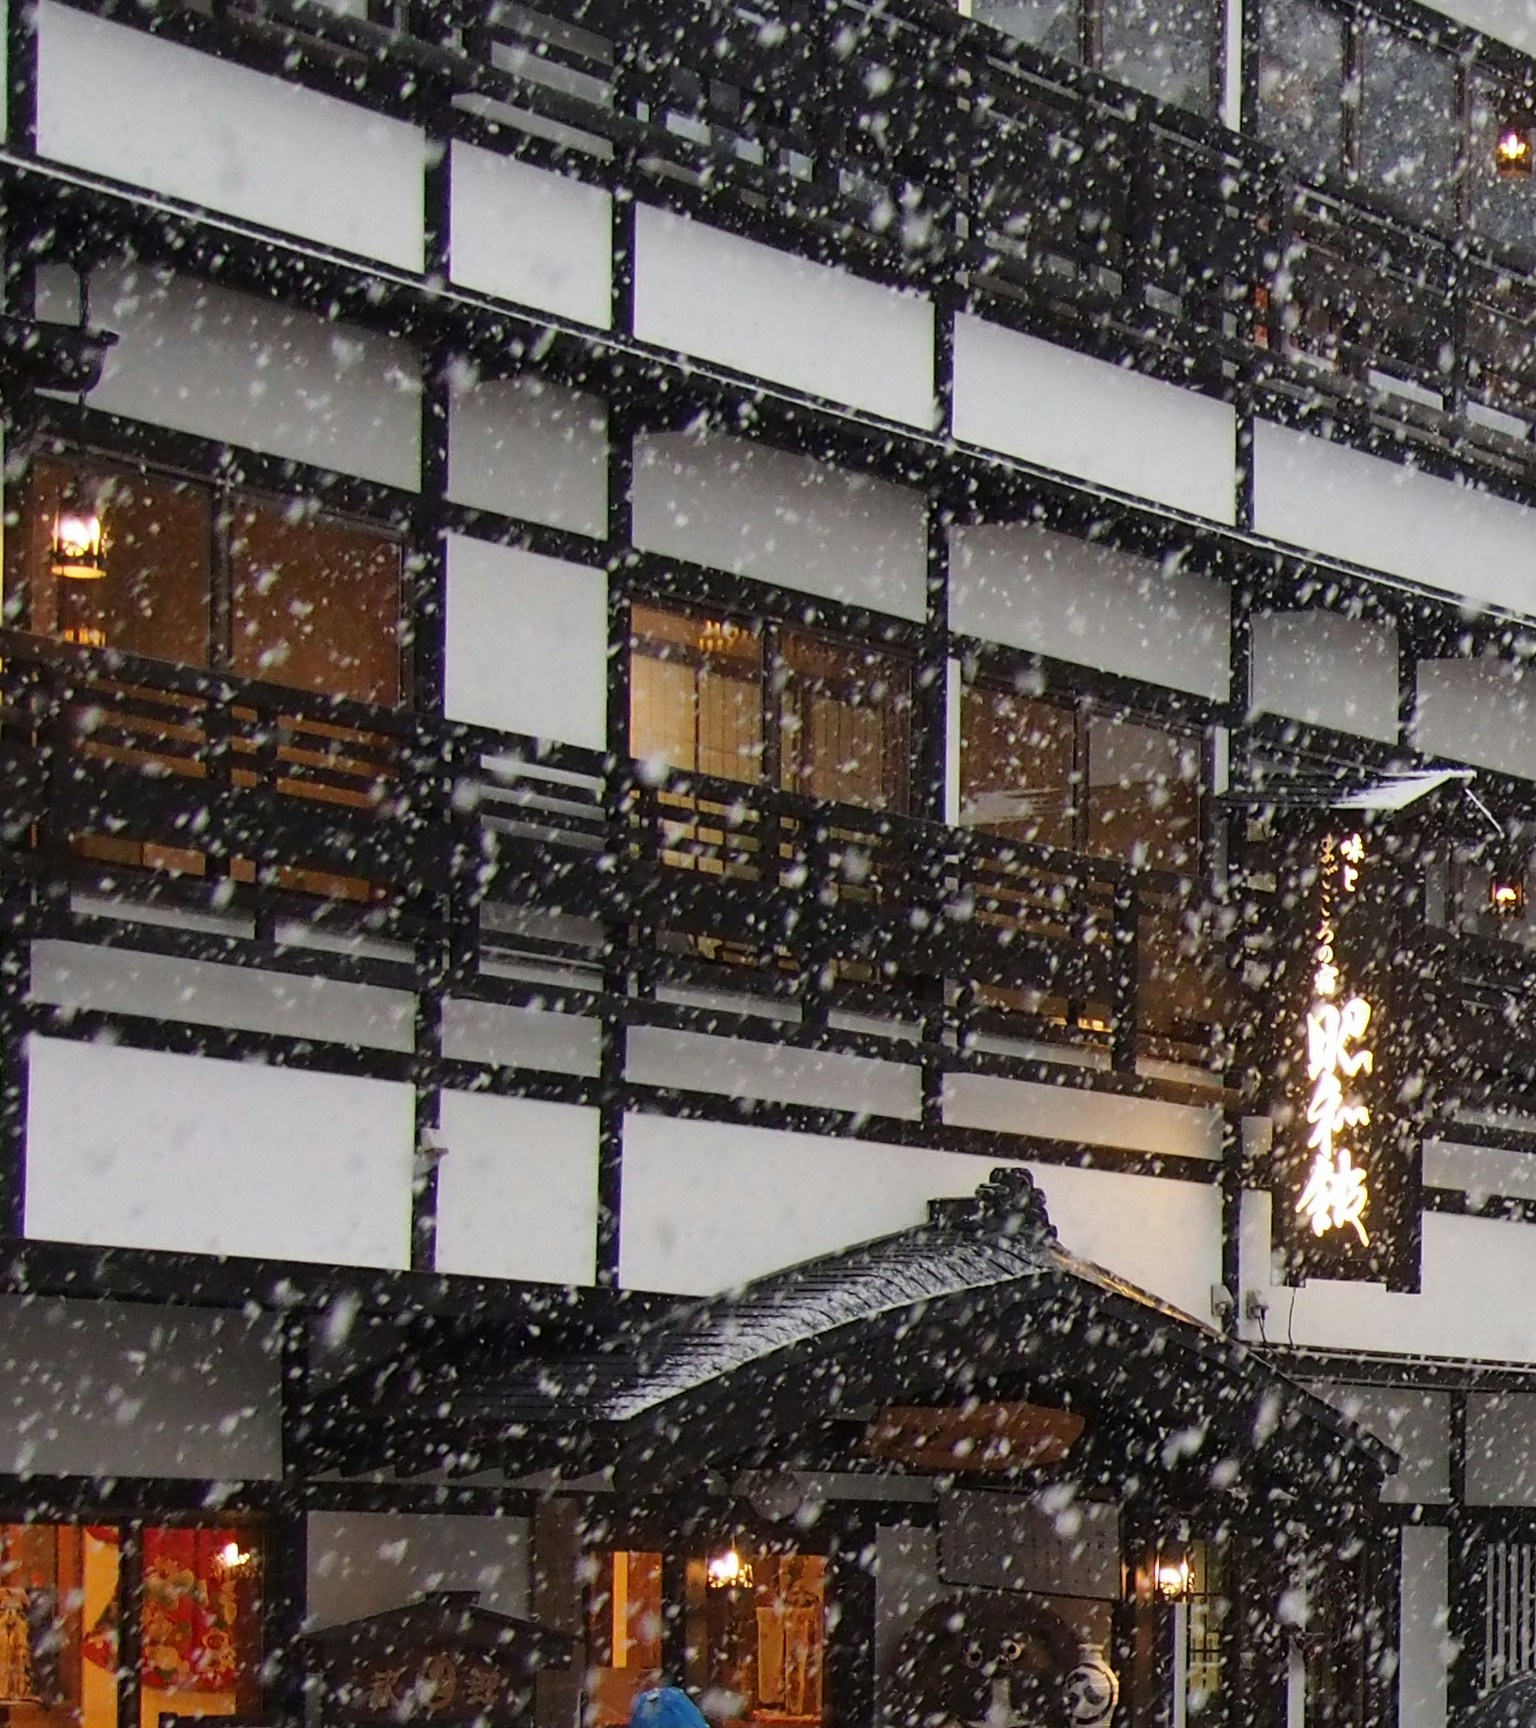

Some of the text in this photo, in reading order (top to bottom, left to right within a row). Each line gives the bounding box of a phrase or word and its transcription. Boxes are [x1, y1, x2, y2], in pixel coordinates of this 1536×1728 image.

[1314, 832, 1341, 996] まごころの宿
[1340, 833, 1366, 892] 味と
[1294, 997, 1374, 1248] 昭和館
